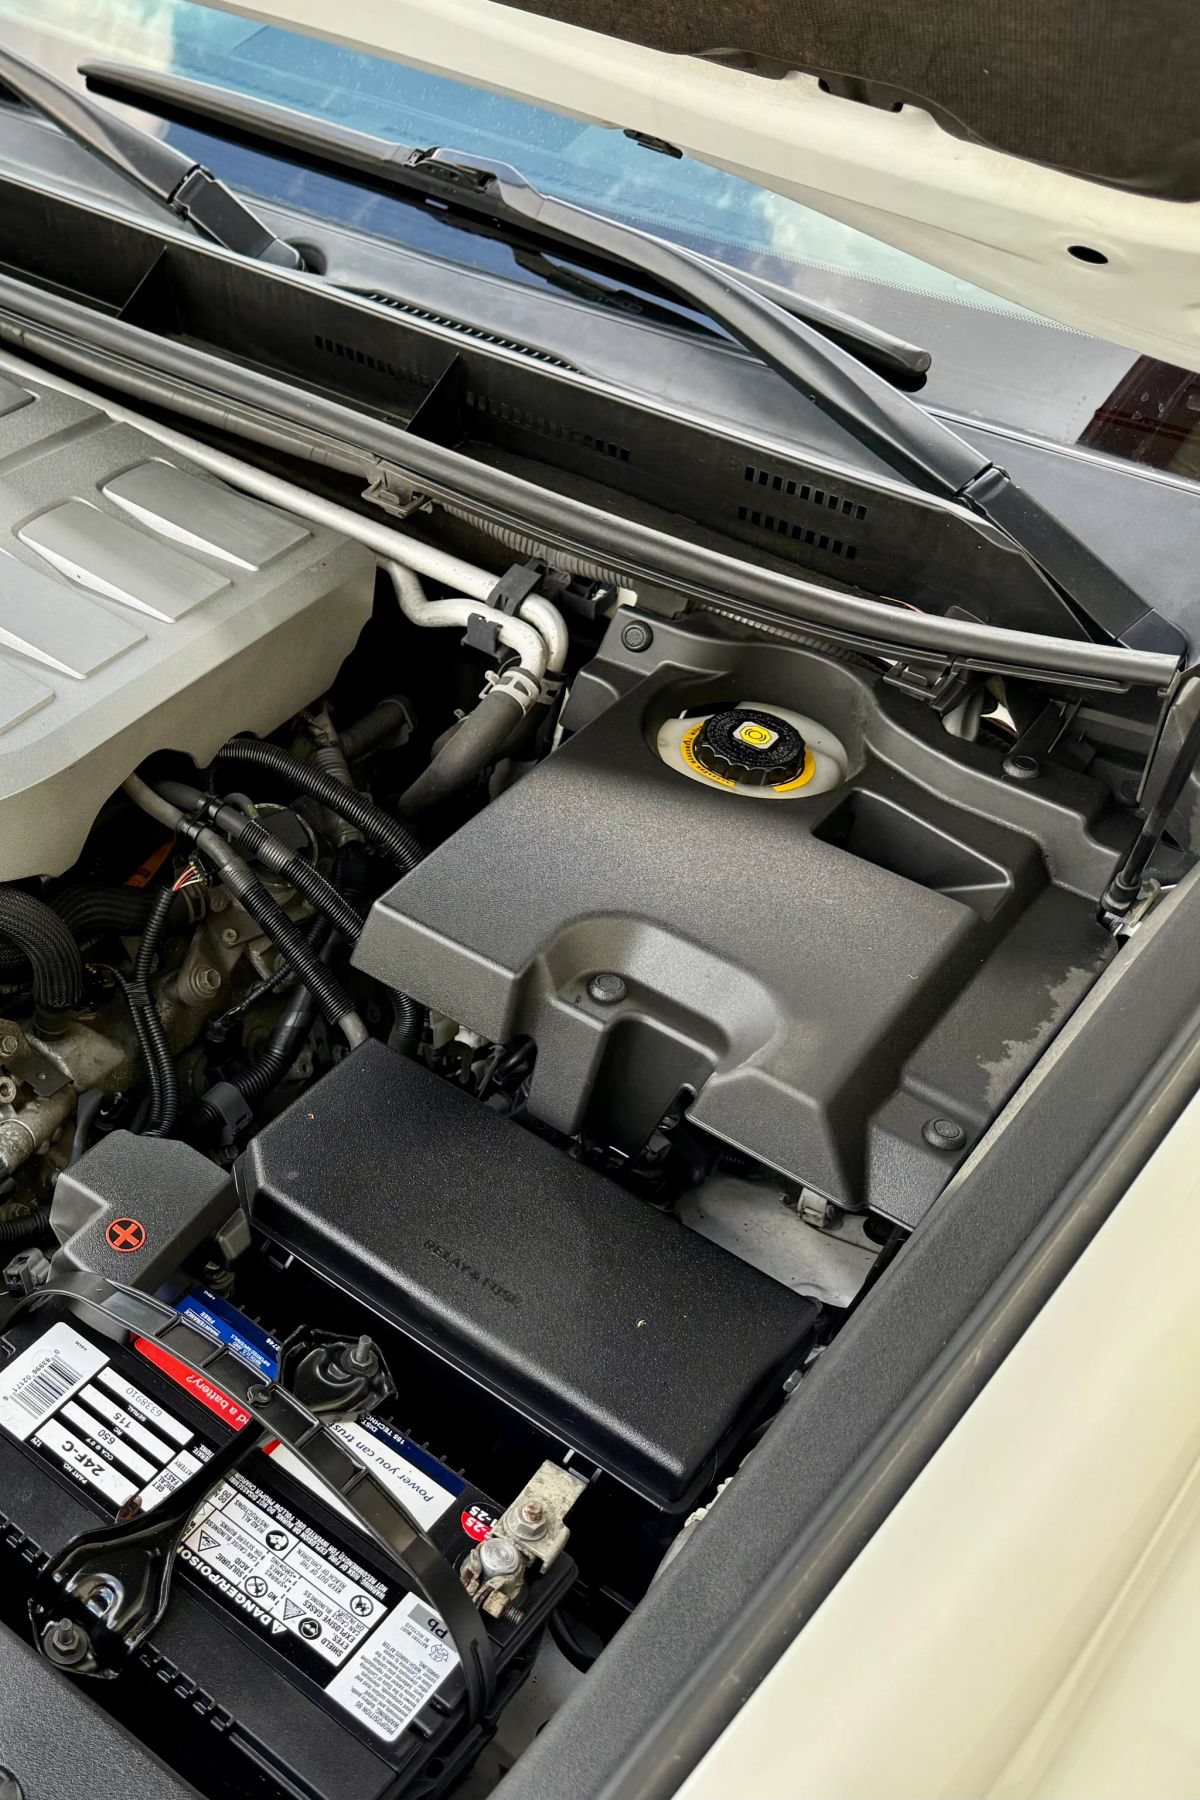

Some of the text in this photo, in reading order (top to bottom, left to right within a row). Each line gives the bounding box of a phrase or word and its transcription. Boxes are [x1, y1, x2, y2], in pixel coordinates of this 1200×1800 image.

[423, 1239, 472, 1275] RELAY
[183, 1308, 220, 1338] MAINTENANCE
[199, 1310, 216, 1324] FREE
[184, 1370, 231, 1410] battery?
[124, 1385, 163, 1417] 6338910
[125, 1403, 147, 1422] SERIAL
[227, 1405, 238, 1416] a
[112, 1411, 133, 1429] 115
[96, 1427, 116, 1445] 650
[112, 1425, 123, 1436] RC
[391, 1432, 406, 1445] 155
[30, 1435, 43, 1447] 12V
[354, 1440, 375, 1458] can
[59, 1438, 106, 1478] 24F-C
[99, 1448, 114, 1461] CCA
[61, 1461, 88, 1484] PART NO.
[374, 1453, 400, 1476] you
[151, 1480, 165, 1492] GET
[161, 1470, 180, 1485] FAST.
[254, 1487, 276, 1505] PROPER
[395, 1471, 434, 1503] Power
[255, 1496, 269, 1509] NOT
[265, 1505, 276, 1514] DO
[272, 1501, 295, 1521] FOLLOW
[240, 1512, 265, 1533] READ ALL
[273, 1510, 295, 1528] BURNS,
[292, 1517, 307, 1530] USE.
[204, 1518, 232, 1542] BLINDNESS
[291, 1524, 301, 1534] OR
[303, 1525, 330, 1548] INVERTED
[229, 1538, 248, 1554] CAUSE
[235, 1533, 256, 1551] SEVERE
[298, 1530, 328, 1555] EXPLOSION
[327, 1544, 340, 1556] FOR
[245, 1550, 258, 1562] CAN
[253, 1547, 263, 1556] OR
[325, 1550, 342, 1566] FIRE,
[214, 1551, 245, 1577] SULFURIC
[233, 1556, 250, 1571] ACID
[320, 1567, 330, 1576] OF
[337, 1551, 378, 1585] RECOMMENDED
[338, 1561, 349, 1571] OF
[298, 1558, 342, 1594] KEEP OUT OF THE
[327, 1572, 347, 1589] REACH
[345, 1567, 361, 1580] RISK
[266, 1590, 278, 1601] NO
[357, 1576, 386, 1600] WARNING:
[374, 1580, 388, 1593] NOT
[301, 1598, 356, 1643] EXPLOSIVE GASES
[302, 1589, 361, 1636] CAN CAUSE BLINDNESS
[335, 1607, 365, 1631] OR INJURY
[424, 1616, 450, 1639] Pb
[319, 1636, 344, 1657] SHIELD
[329, 1632, 350, 1650] EYES.
[353, 1700, 396, 1735] PROPOSITION 65
